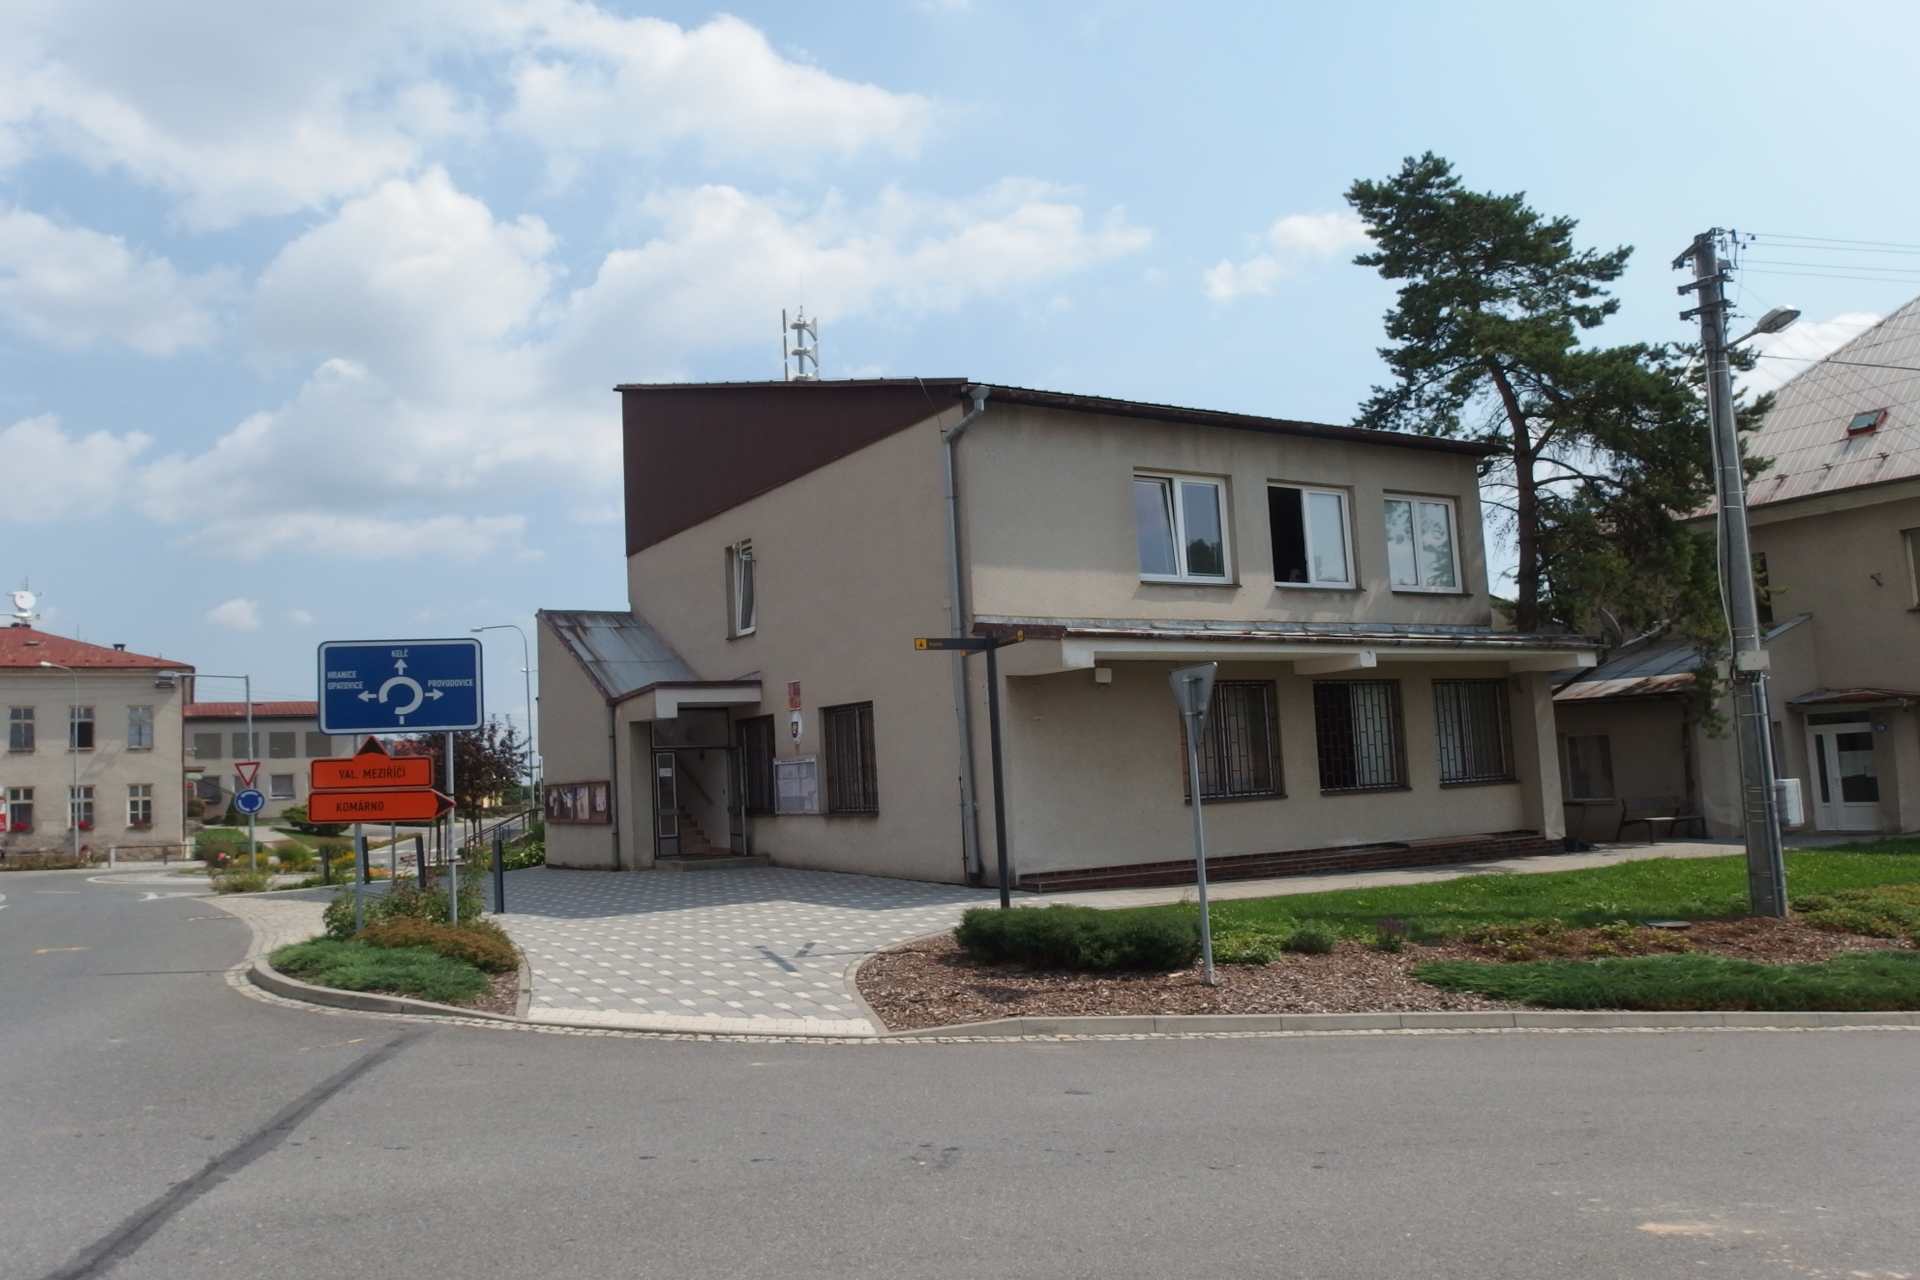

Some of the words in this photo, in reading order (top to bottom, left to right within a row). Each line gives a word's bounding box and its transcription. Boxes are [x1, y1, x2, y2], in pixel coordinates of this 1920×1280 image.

[391, 648, 409, 658] KELČ
[327, 670, 357, 679] HRANICE
[327, 681, 364, 690] OPATOVICE
[427, 678, 474, 688] PROVODOVICE
[338, 769, 359, 779] VAL.
[363, 765, 406, 779] MEZIŘÍČÍ
[336, 800, 384, 812] KOMÁRNO
